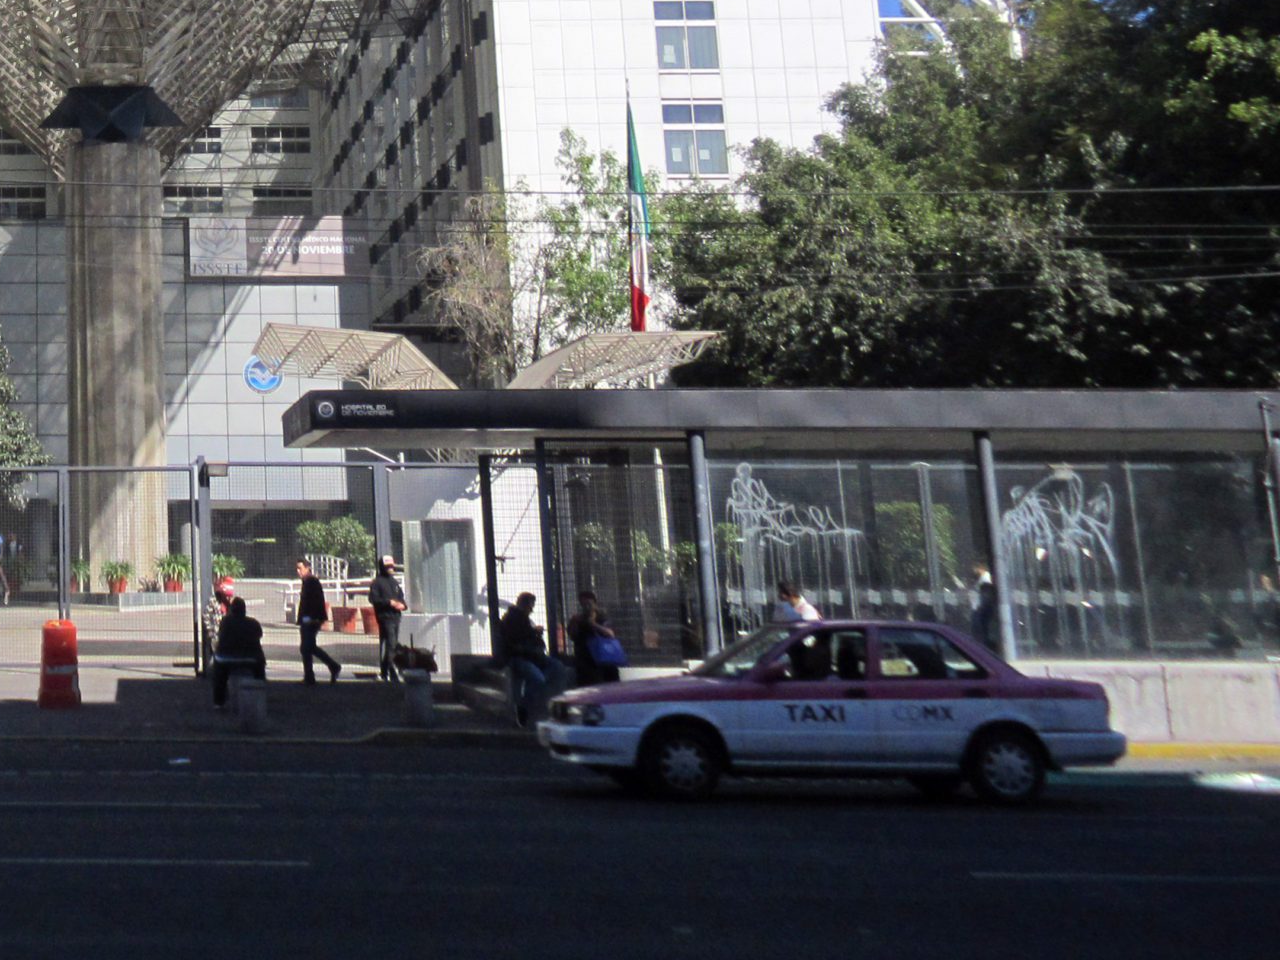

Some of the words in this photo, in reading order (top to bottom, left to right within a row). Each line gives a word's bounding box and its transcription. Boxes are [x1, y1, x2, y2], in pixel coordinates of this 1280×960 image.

[293, 246, 355, 255] NOVIEMBRE
[193, 263, 244, 275] ISSSTE
[783, 704, 847, 723] TAXI
